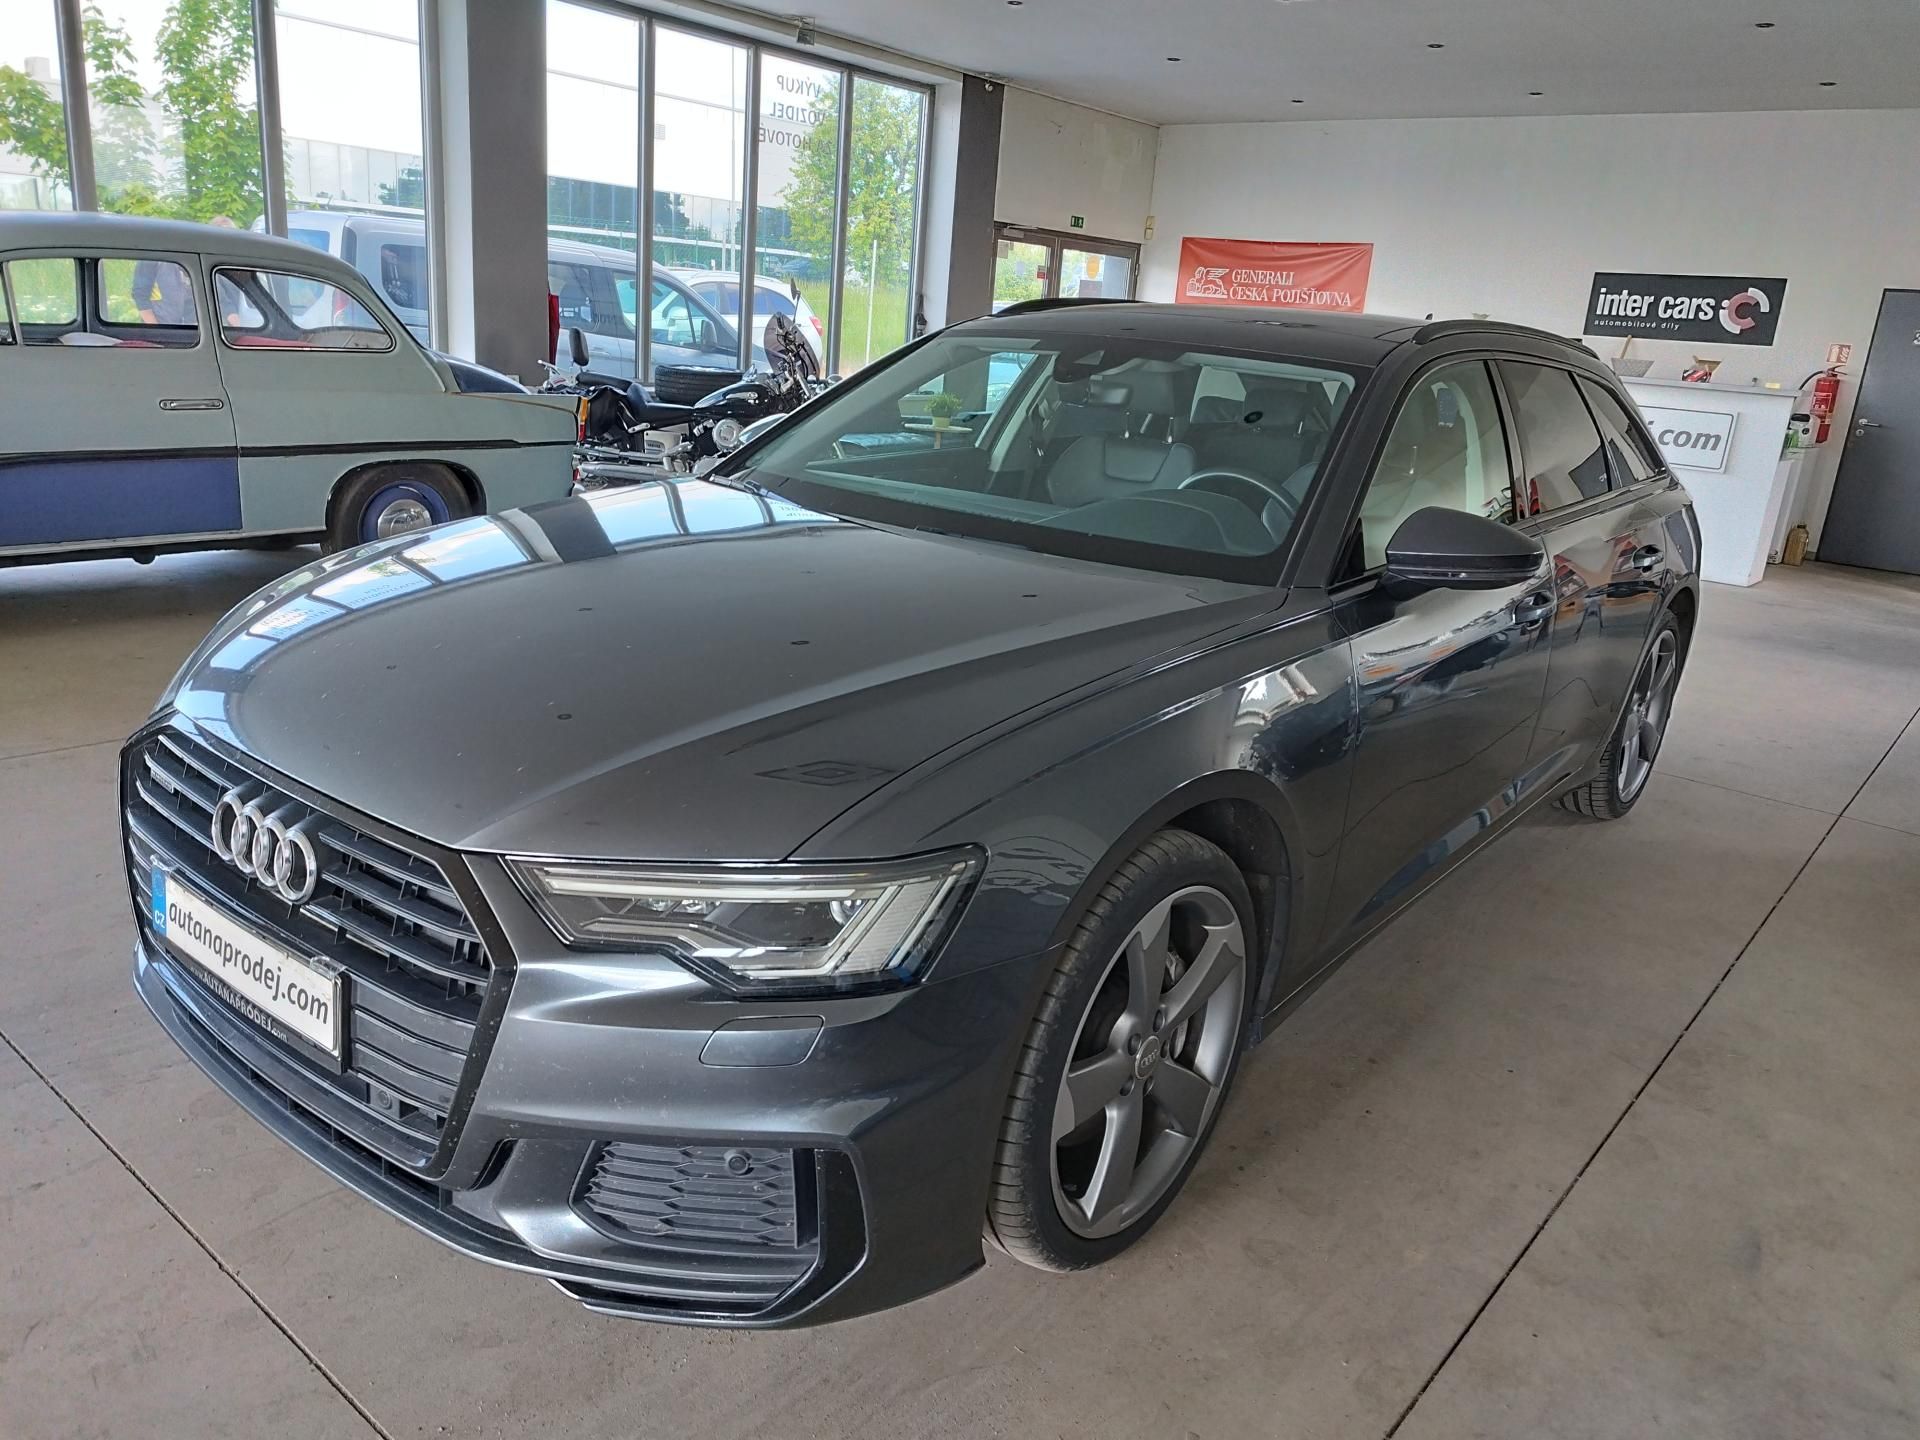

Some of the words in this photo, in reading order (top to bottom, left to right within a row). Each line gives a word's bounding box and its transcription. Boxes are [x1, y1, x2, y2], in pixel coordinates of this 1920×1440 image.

[1231, 269, 1295, 286] GENERALI
[1229, 284, 1270, 302] ČESKÁ
[1272, 287, 1352, 307] POJIŠŤOVNA
[1595, 287, 1655, 318] inter
[1657, 295, 1716, 321] cars
[1594, 319, 1657, 329] automobilové
[1660, 322, 1680, 331] díly
[1647, 420, 1722, 451] com
[154, 911, 166, 929] CZ
[168, 901, 329, 1024] autanaprodej.com
